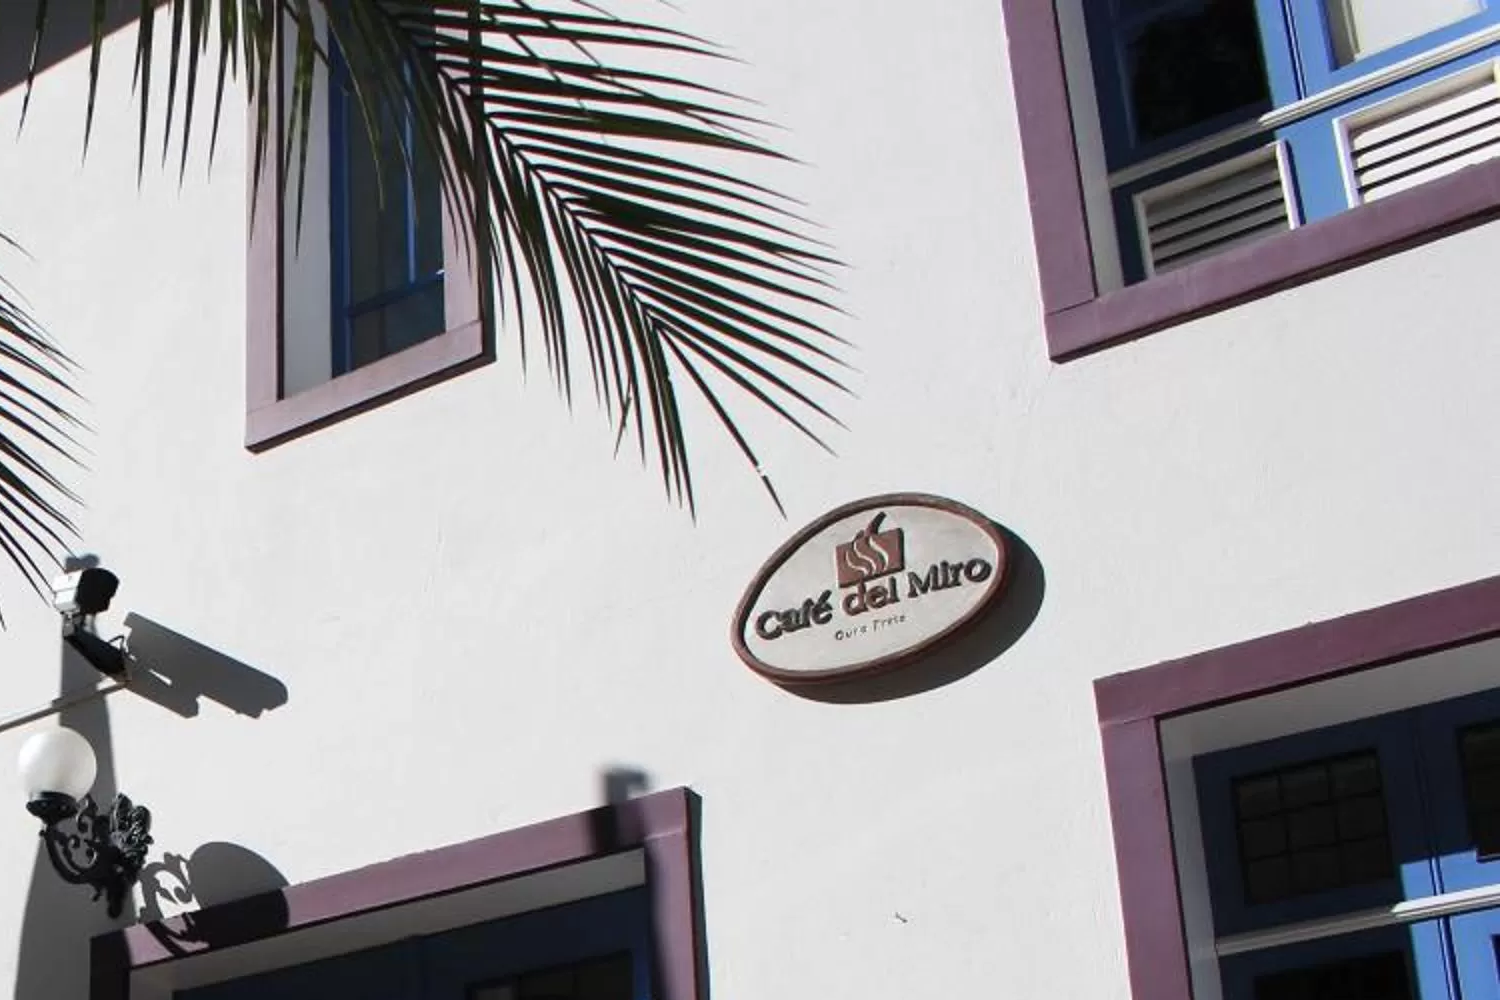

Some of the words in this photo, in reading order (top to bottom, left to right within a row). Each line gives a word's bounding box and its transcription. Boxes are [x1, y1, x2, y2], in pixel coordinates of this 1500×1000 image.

[755, 589, 833, 640] Café
[841, 577, 900, 616] del
[907, 558, 992, 598] Miro
